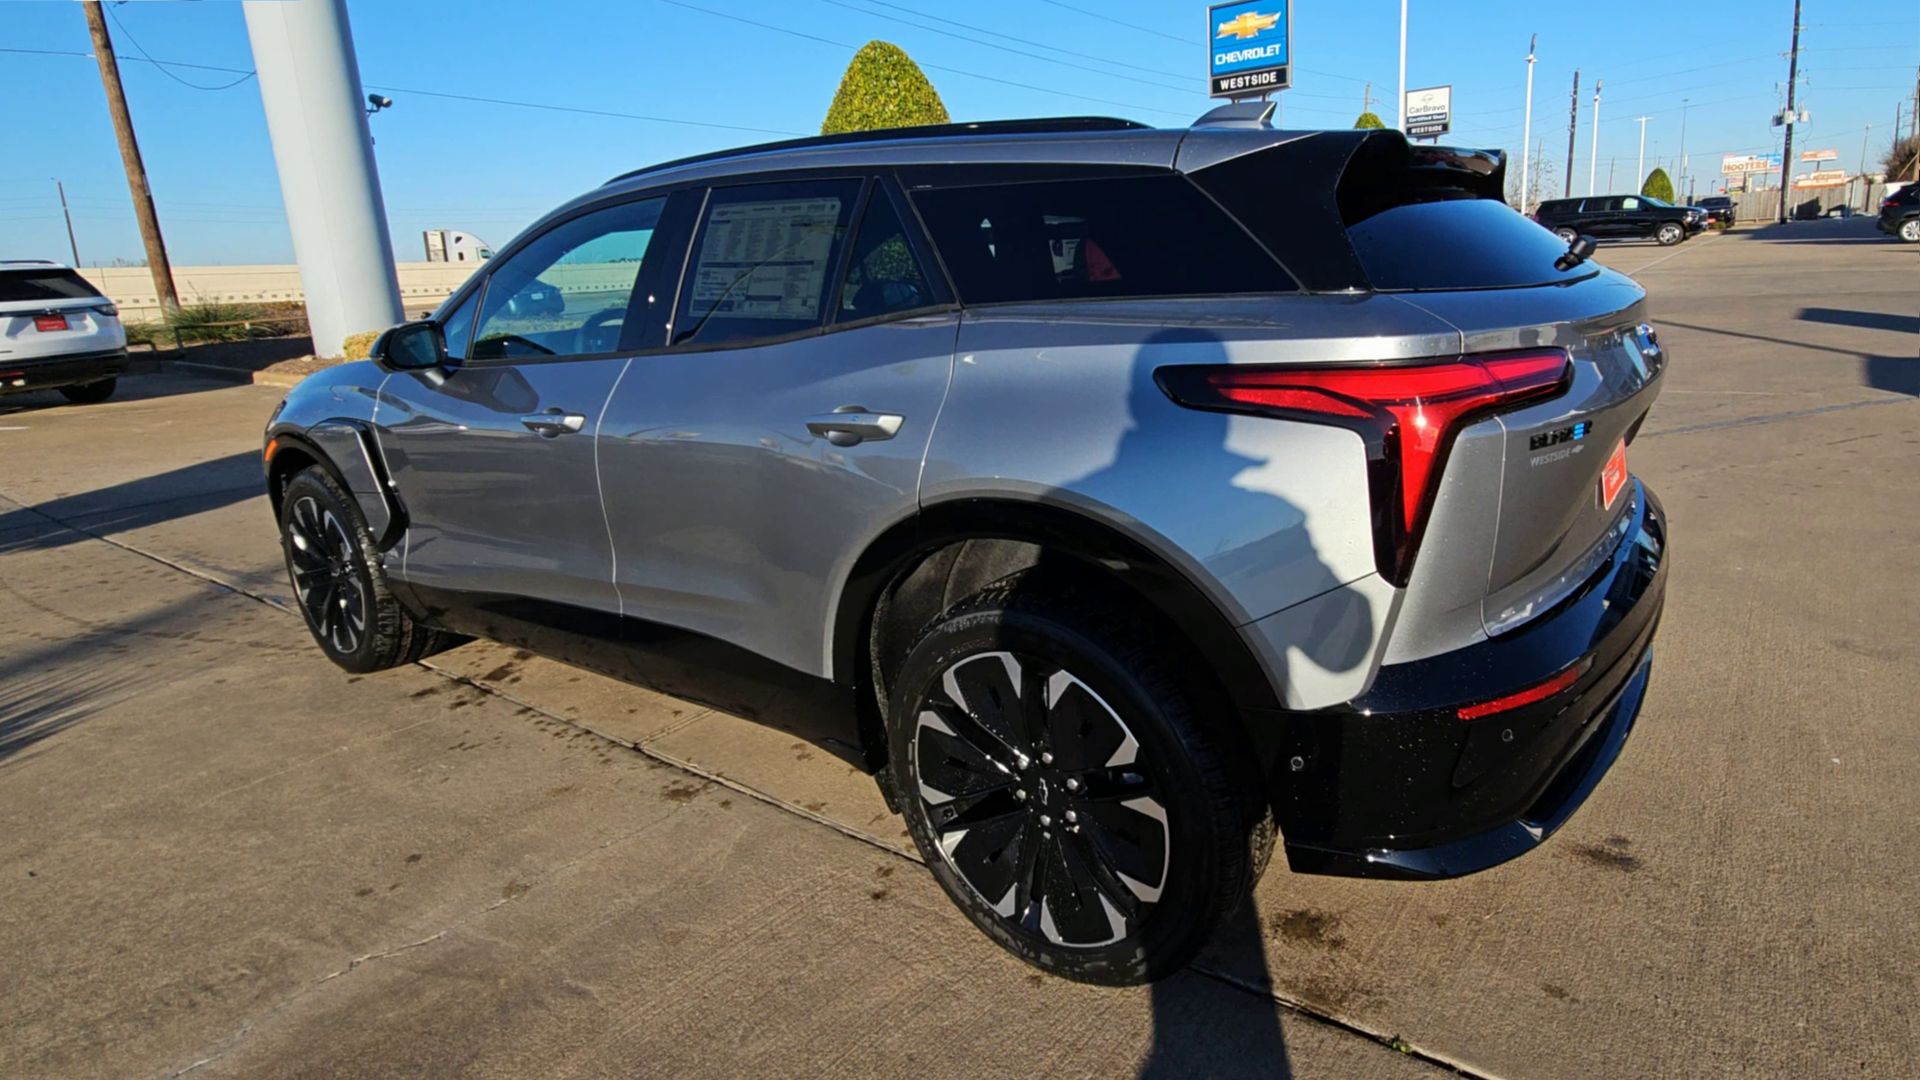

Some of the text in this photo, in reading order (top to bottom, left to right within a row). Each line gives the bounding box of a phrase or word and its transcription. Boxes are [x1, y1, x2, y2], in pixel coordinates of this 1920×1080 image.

[1215, 44, 1281, 65] CHEVROLET
[1220, 72, 1277, 90] WESTSIDE
[1409, 104, 1446, 114] CarBravo
[1411, 124, 1443, 133] WESTSIDE
[1723, 160, 1768, 171] HOOTERS
